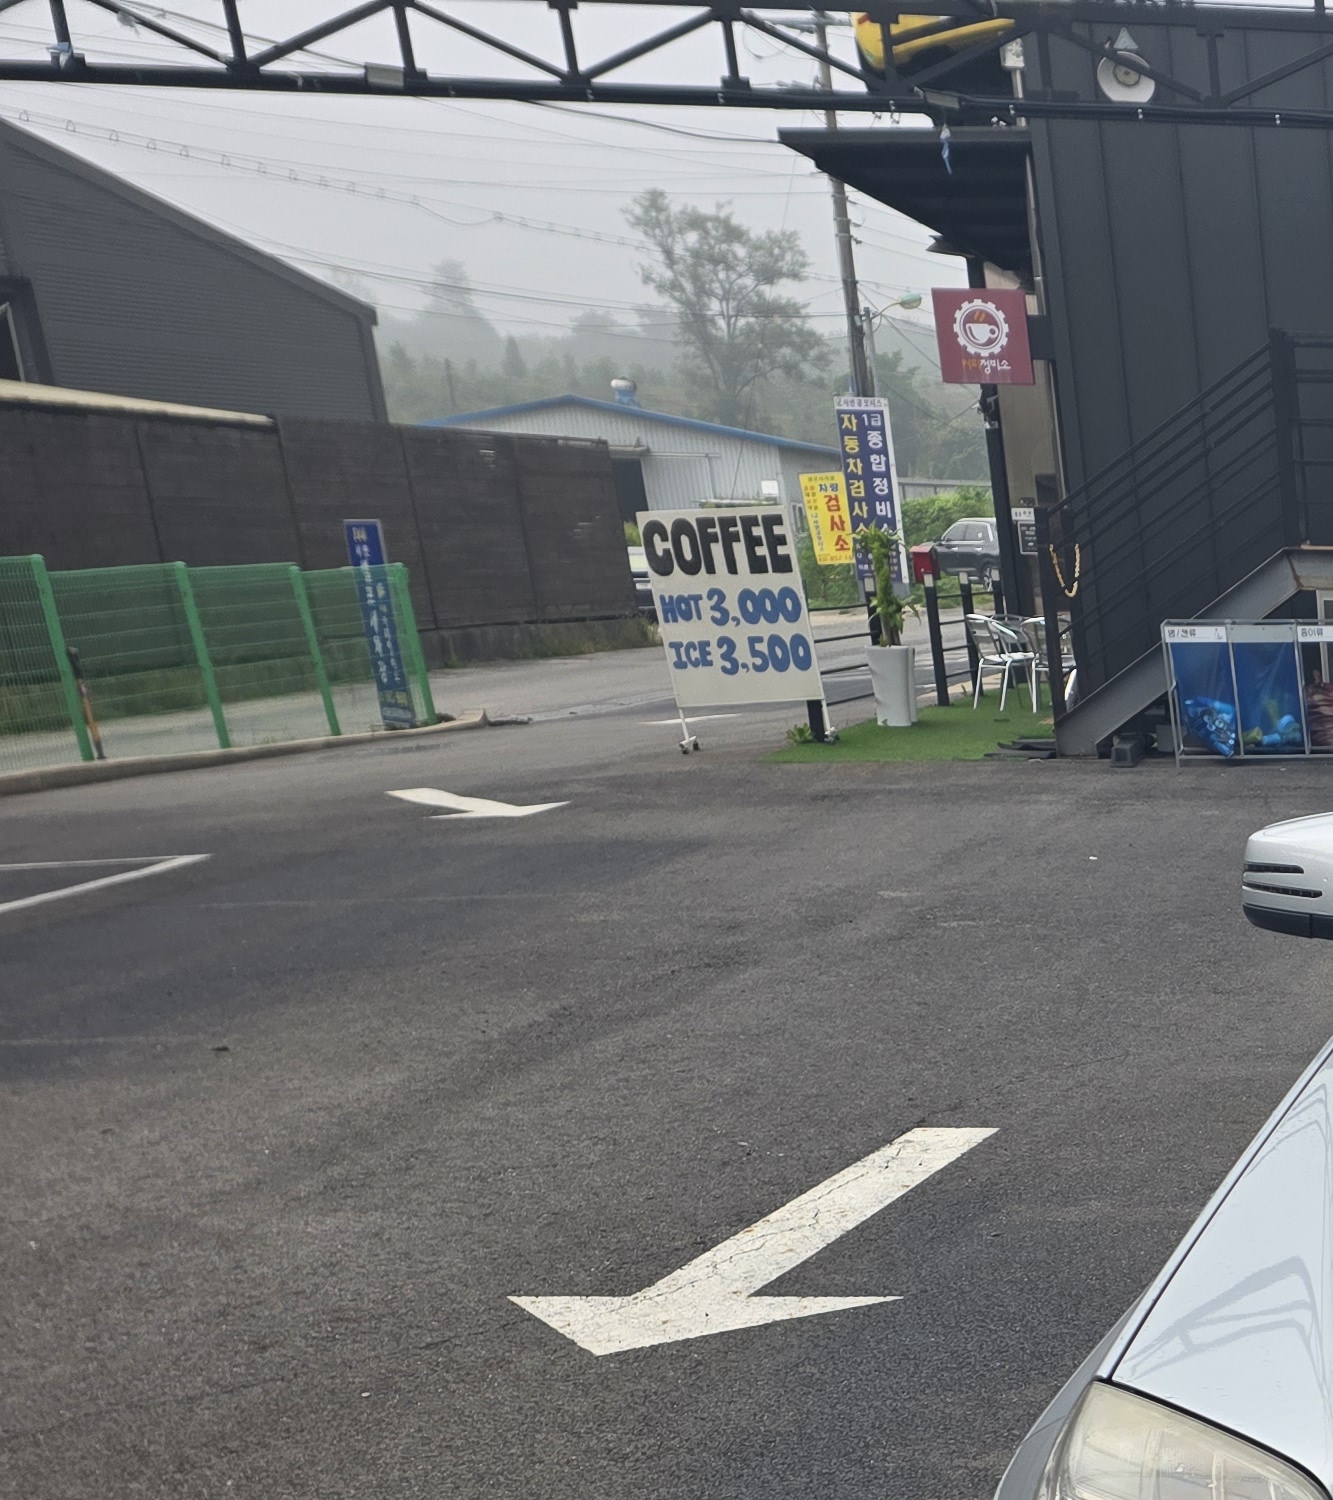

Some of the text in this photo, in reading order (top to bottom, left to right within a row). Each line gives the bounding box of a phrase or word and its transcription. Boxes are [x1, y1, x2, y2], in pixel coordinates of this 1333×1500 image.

[861, 413, 882, 427] 1급
[824, 493, 850, 552] 검사소
[642, 513, 794, 577] COFFEE
[659, 586, 803, 627] HOT 3,000
[668, 632, 813, 676] ICE 3,500
